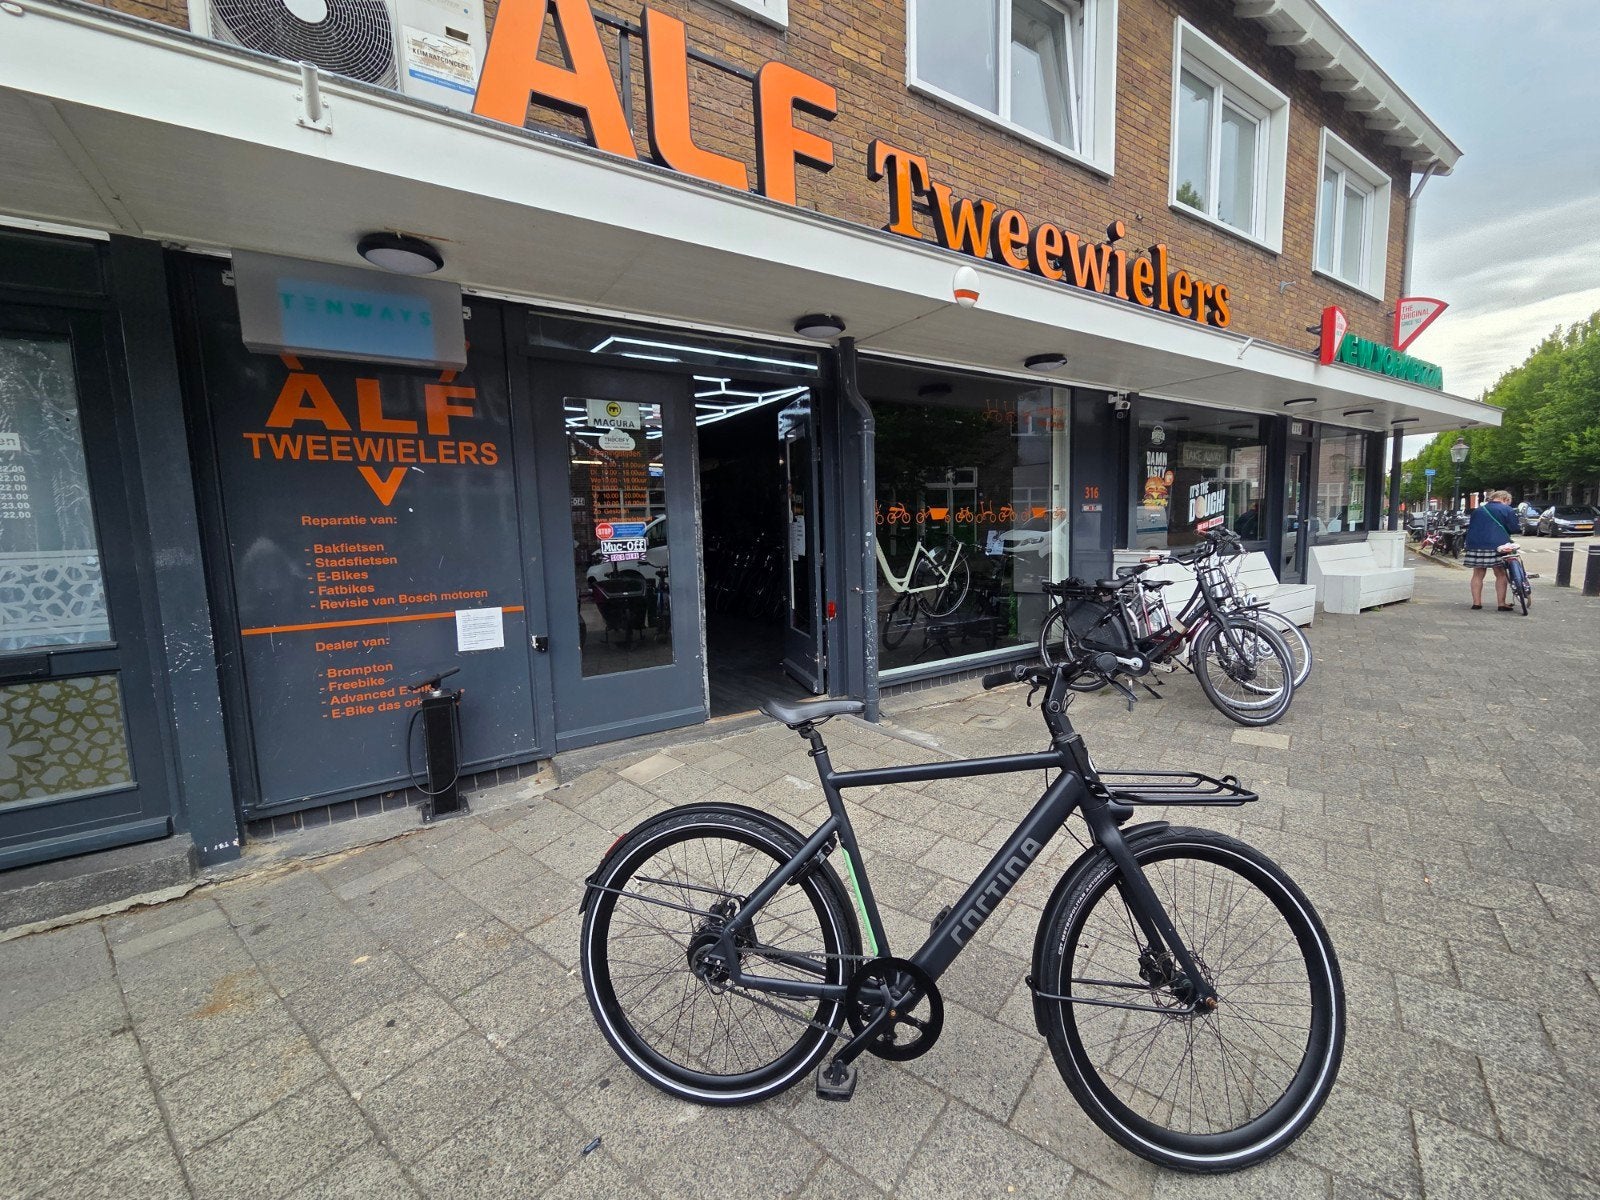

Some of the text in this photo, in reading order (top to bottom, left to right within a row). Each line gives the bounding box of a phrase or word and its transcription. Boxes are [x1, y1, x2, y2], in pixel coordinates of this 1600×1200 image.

[472, 0, 838, 206] ALF
[868, 139, 1231, 328] Tweewielers
[281, 292, 432, 328] TENWAYS
[1402, 305, 1413, 313] THE
[1402, 308, 1429, 320] ORIGINAL
[265, 372, 476, 435] ALF
[593, 418, 635, 428] MAGURA
[243, 432, 498, 466] TWEEWIELERS
[1146, 451, 1168, 465] DAMN
[1147, 465, 1168, 479] TASTY
[1085, 487, 1099, 499] 316
[1190, 481, 1210, 498] IT'S THE
[301, 515, 398, 528] Reparatie van:
[597, 528, 612, 536] STOP
[313, 543, 384, 554] Bakfietsen
[603, 540, 644, 552] Muc-Off
[315, 556, 398, 568] Stadsfietsen
[317, 570, 369, 582] E-Bikes
[318, 584, 375, 596] Fatbikes
[320, 597, 369, 610] Revisie
[372, 597, 395, 606] van
[398, 592, 437, 604] Bosch
[441, 590, 488, 600] motoren
[315, 637, 390, 652] Dealer van:
[327, 663, 394, 678] Brompton
[328, 677, 385, 692] Freebike
[330, 687, 395, 706] Advanced
[331, 705, 374, 719] E-Bike
[377, 702, 401, 712] das
[404, 697, 422, 708] ori
